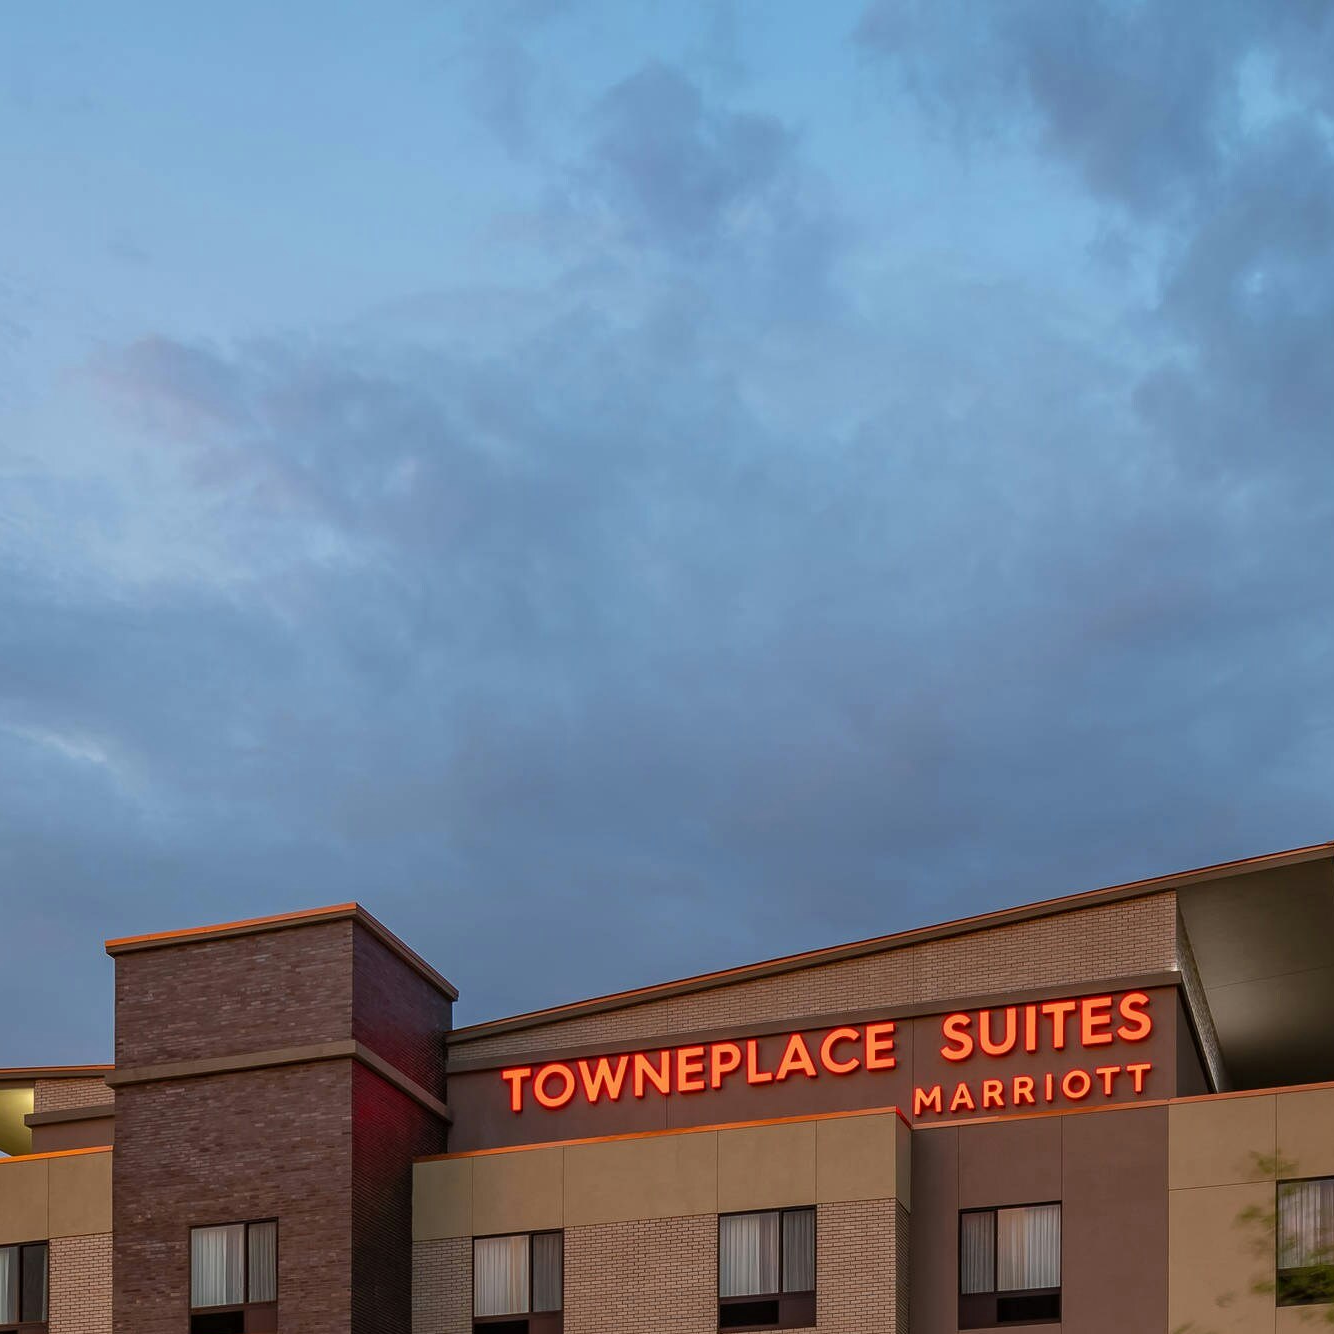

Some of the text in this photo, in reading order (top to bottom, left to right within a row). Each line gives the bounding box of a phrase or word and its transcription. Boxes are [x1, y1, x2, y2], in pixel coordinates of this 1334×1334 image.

[501, 992, 1152, 1112] TOWNEPLACE SUITES
[914, 1063, 1152, 1116] MARRIOTT
